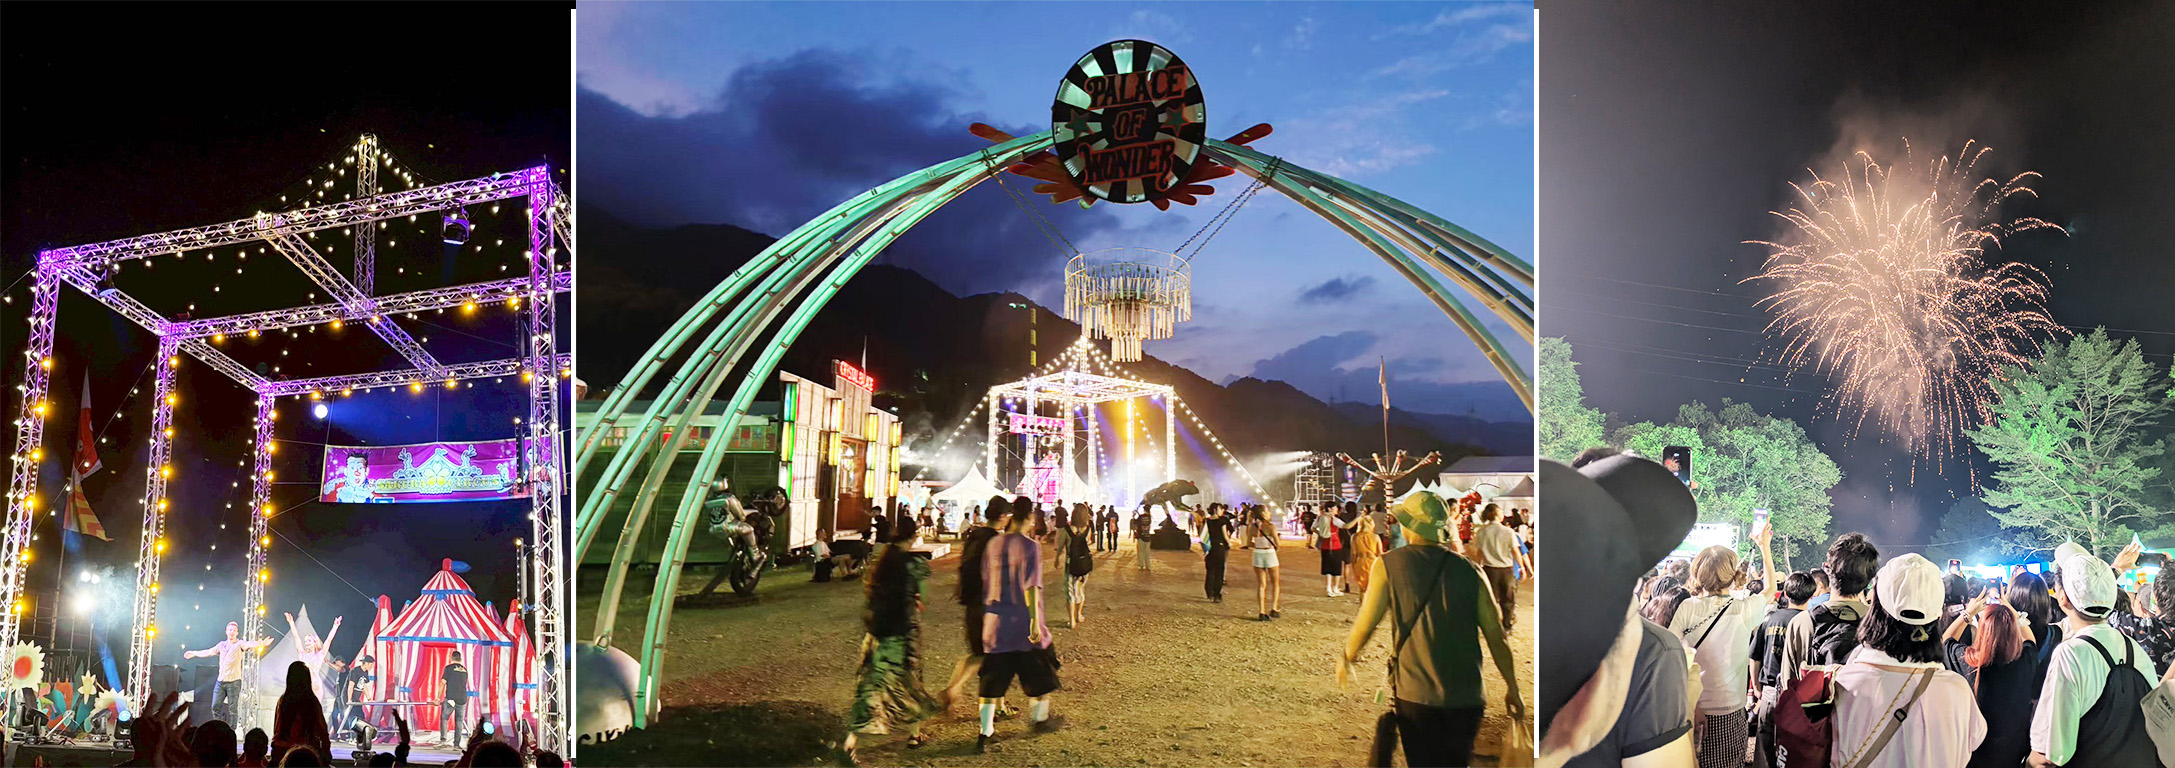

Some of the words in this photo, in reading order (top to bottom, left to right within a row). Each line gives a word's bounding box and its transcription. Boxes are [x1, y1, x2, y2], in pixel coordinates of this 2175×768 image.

[1084, 65, 1188, 111] PALACE
[1114, 108, 1147, 141] OF
[1077, 139, 1176, 192] WONDER
[446, 477, 500, 488] CIRCUS
